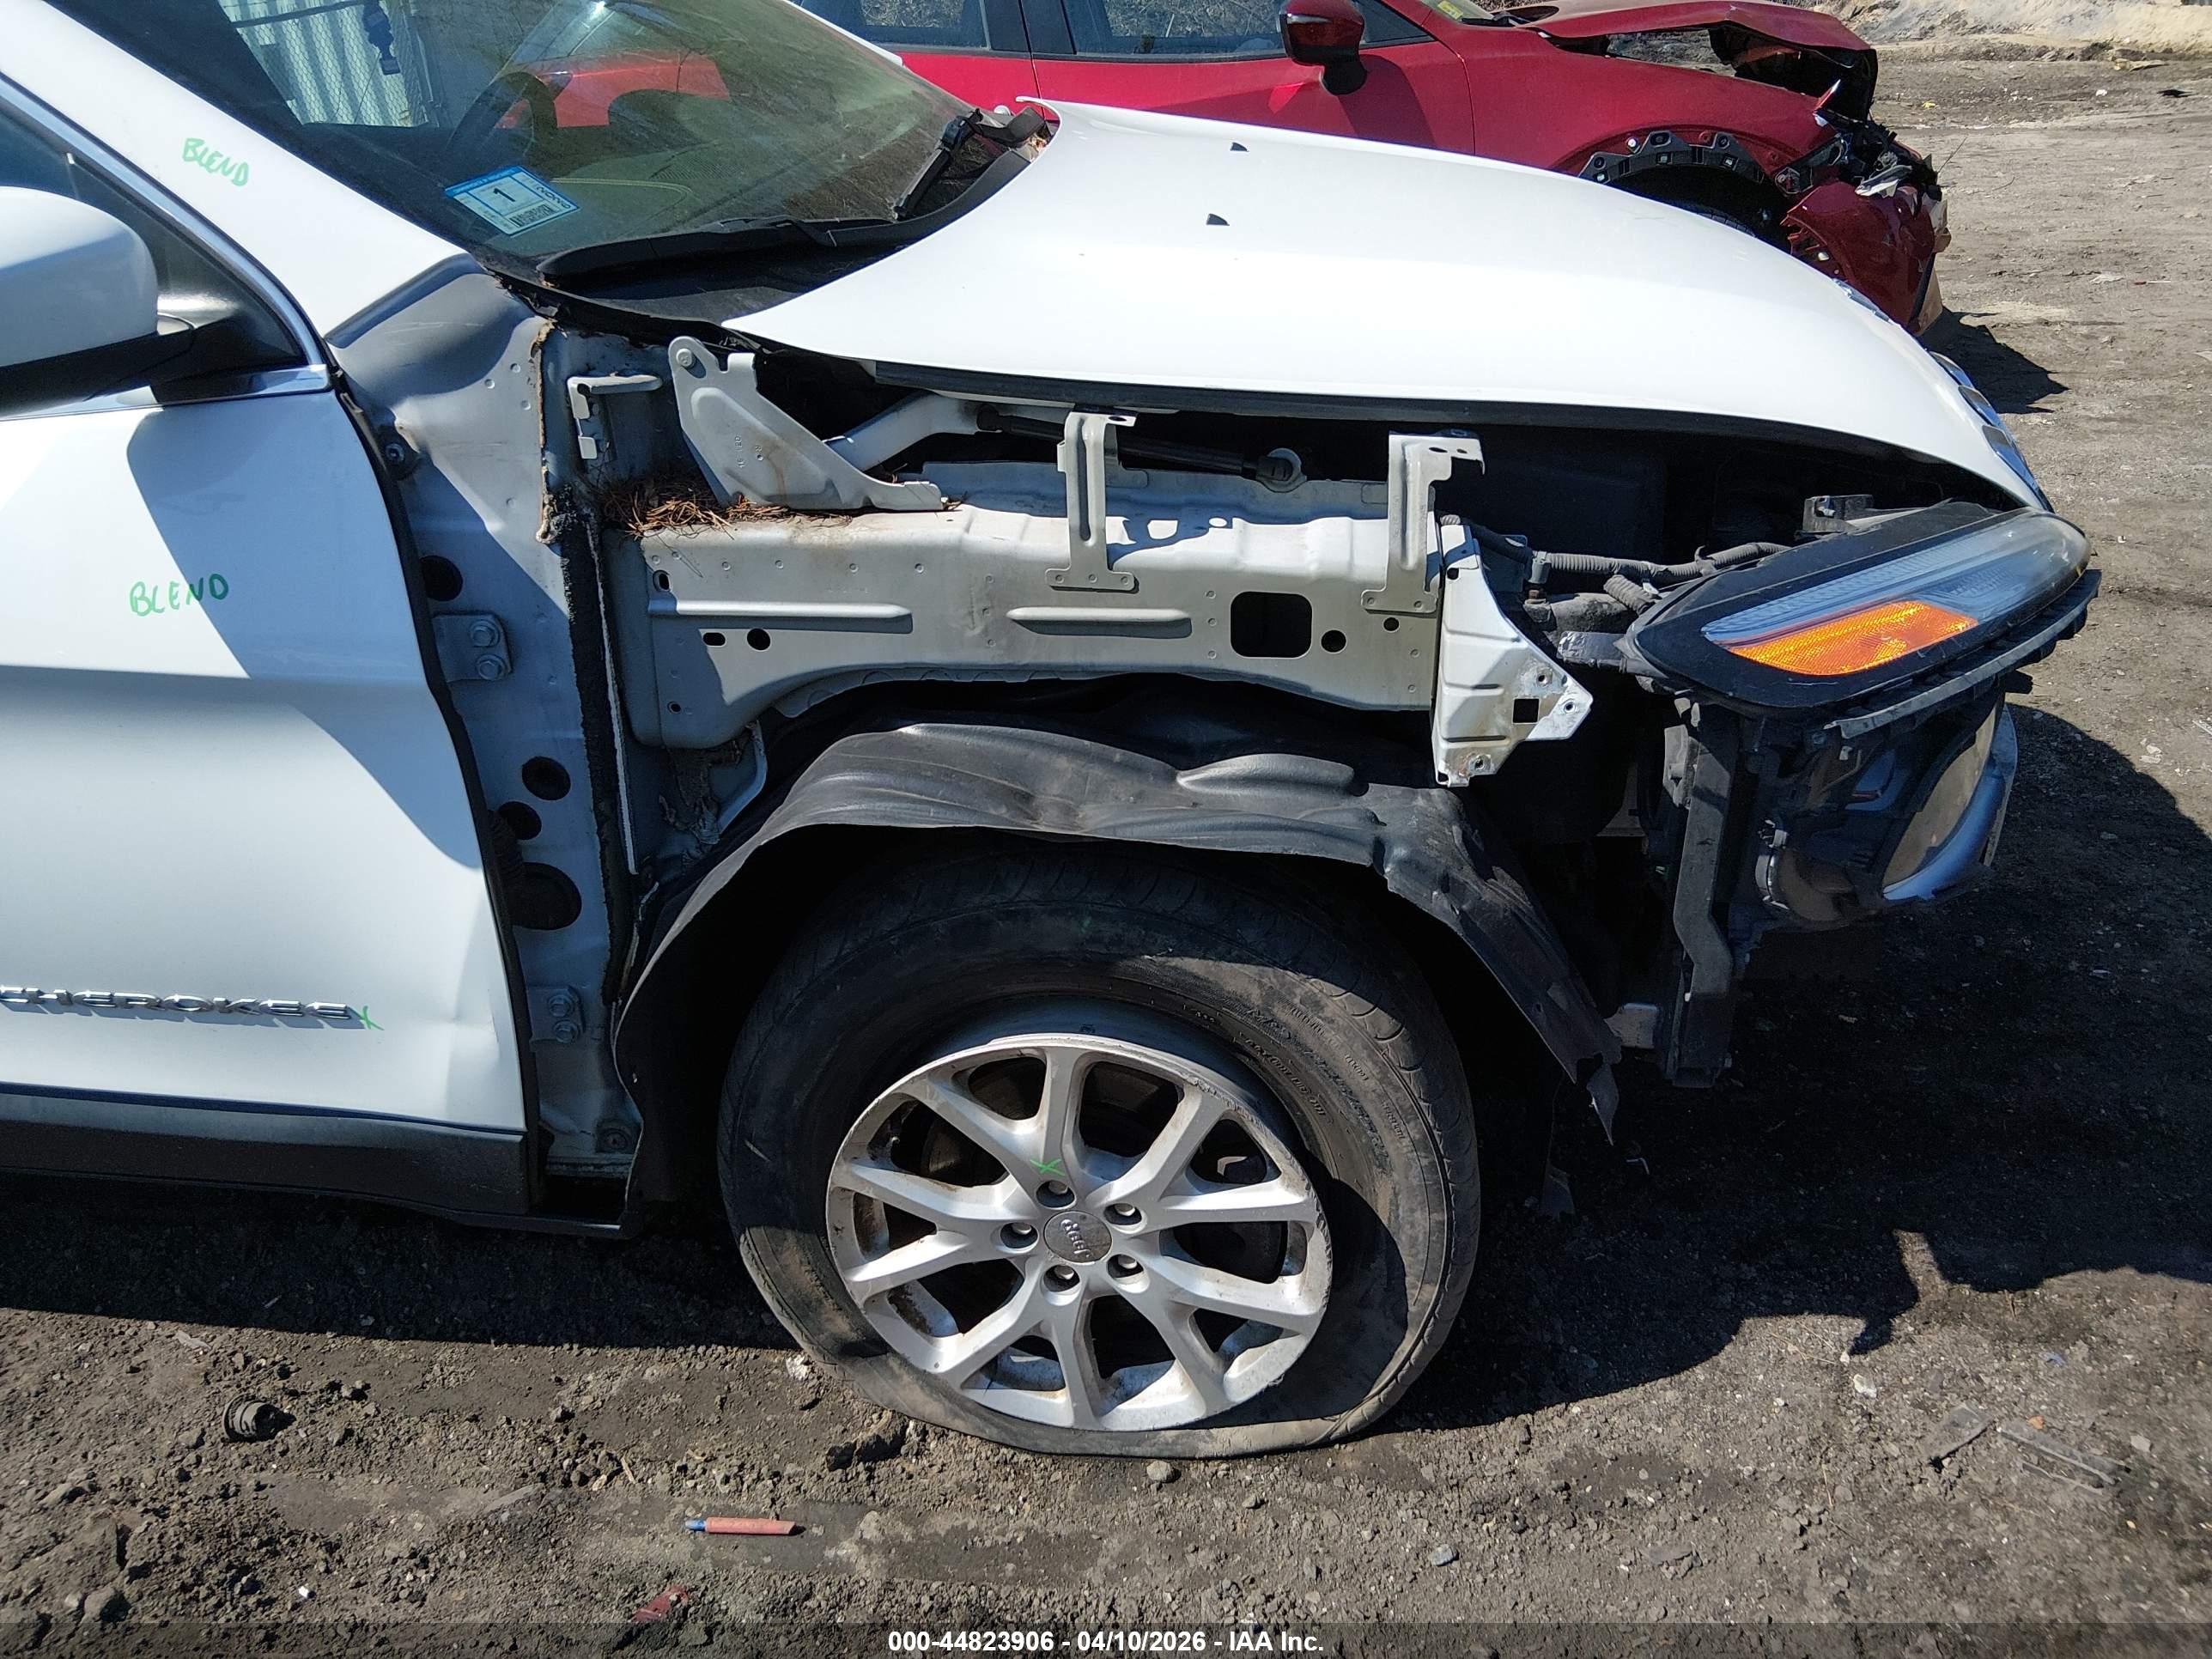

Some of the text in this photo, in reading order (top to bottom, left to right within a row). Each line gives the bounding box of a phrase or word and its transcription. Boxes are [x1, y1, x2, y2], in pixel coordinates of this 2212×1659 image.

[182, 137, 249, 186] BLEND
[492, 187, 516, 203] 1
[130, 573, 229, 617] BLEND
[1060, 1218, 1092, 1259] Jeep
